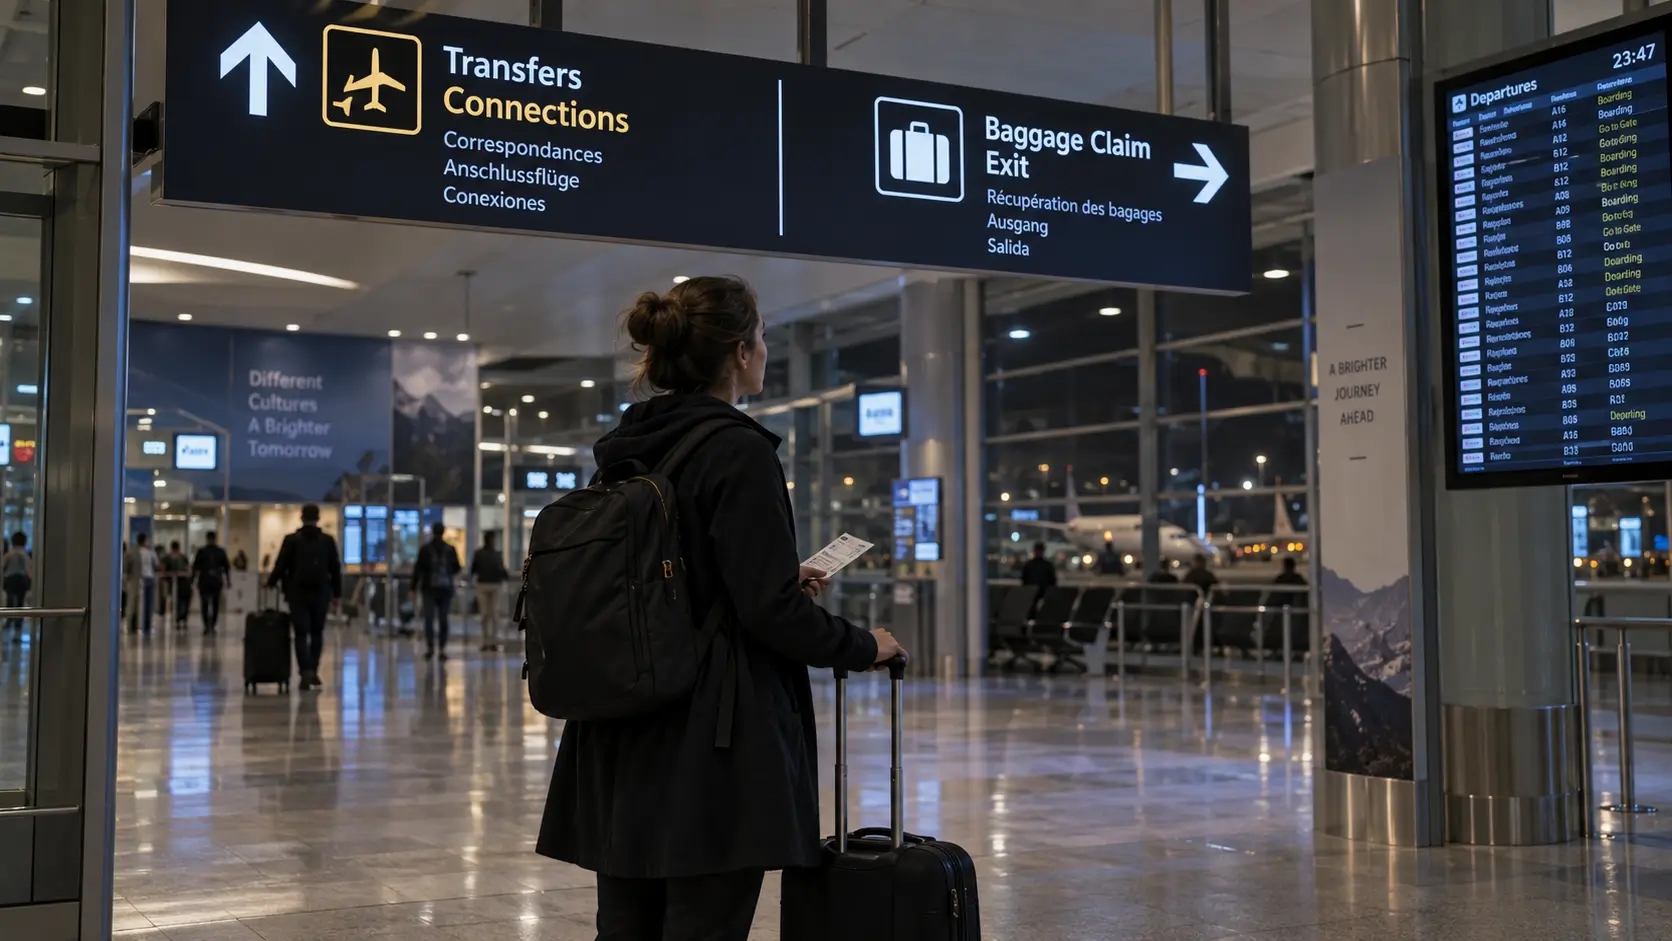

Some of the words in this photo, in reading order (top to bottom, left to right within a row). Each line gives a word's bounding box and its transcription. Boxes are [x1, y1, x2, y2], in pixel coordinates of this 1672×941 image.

[443, 46, 582, 90] Transfers
[1470, 79, 1538, 107] Departures
[1612, 43, 1656, 69] 23:47
[1597, 90, 1632, 106] Boarding
[443, 85, 630, 134] Connections
[443, 131, 604, 165] Correspondances
[985, 116, 1084, 156] Baggage
[1090, 130, 1151, 160] Claim
[985, 150, 1030, 179] Exit
[1600, 149, 1637, 162] Boarding
[443, 159, 580, 191] Anschlussflüge
[1600, 164, 1637, 177] Boarding
[443, 186, 546, 213] Conexiones
[987, 189, 1078, 214] Récupération
[1082, 199, 1105, 217] des
[1108, 201, 1163, 224] bagages
[1601, 193, 1639, 207] Boarding
[987, 213, 1049, 238] Ausgang
[987, 238, 1030, 257] Salida
[1329, 363, 1336, 376] A
[1338, 356, 1387, 375] BRIGHTER
[249, 369, 323, 390] Different
[248, 392, 318, 413] Cultures
[1334, 382, 1381, 401] JOURNEY
[248, 416, 260, 433] A
[265, 416, 332, 439] Brighter
[1340, 409, 1375, 426] AHEAD
[247, 439, 333, 460] Tomorrow
